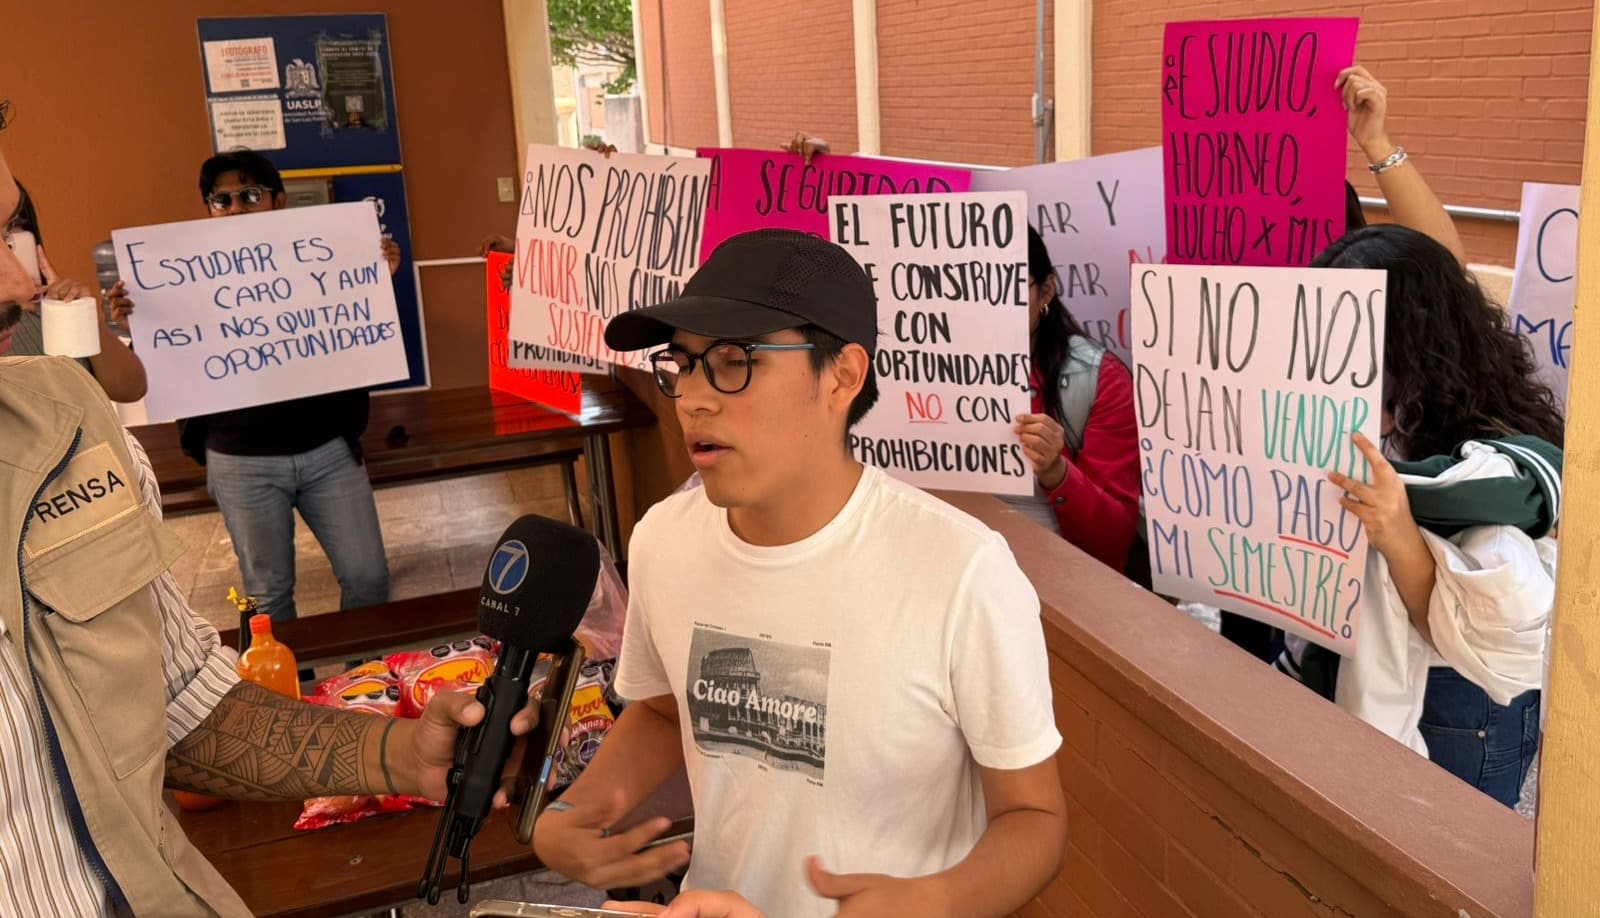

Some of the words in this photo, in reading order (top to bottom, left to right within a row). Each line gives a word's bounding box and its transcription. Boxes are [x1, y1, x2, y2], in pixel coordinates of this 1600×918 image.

[1170, 132, 1304, 206] HORNEO,
[591, 161, 709, 277] PROHÍBEN
[835, 202, 870, 246] EL
[890, 201, 1014, 250] FUTURO
[1037, 201, 1079, 238] AR
[1096, 179, 1119, 227] Y
[292, 237, 334, 262] ES
[1172, 203, 1247, 265] LUCHO
[214, 277, 292, 309] CARO
[310, 271, 327, 296] Y
[339, 262, 379, 290] AUN
[516, 238, 584, 308] VENDER,
[585, 253, 620, 320] NOS
[864, 262, 879, 302] E
[891, 260, 1028, 306] CONSTRUYE
[1055, 262, 1108, 298] JAR
[153, 324, 203, 349] ASI
[220, 316, 269, 339] NOS
[276, 297, 371, 333] QUITAN
[894, 309, 952, 345] CON
[1141, 270, 1175, 357] SI
[1196, 276, 1260, 373] NO
[1286, 283, 1383, 388] NOS
[204, 321, 396, 380] OPORTUNIDADES
[875, 349, 1032, 393] ORTUNIDADES
[905, 391, 944, 422] NO
[956, 395, 1012, 424] CON
[1136, 363, 1244, 456] DEJAN
[1261, 388, 1369, 484] VENDER
[849, 434, 1026, 478] PROHIBICIONES
[34, 470, 125, 523] RENSA
[1269, 469, 1364, 554] PAGO
[494, 544, 527, 593] 7
[1151, 518, 1194, 579] MI
[1207, 526, 1362, 639] SEMESTRE?
[480, 596, 509, 614] CANAL
[514, 606, 521, 616] 7
[692, 679, 741, 706] Ciao
[745, 687, 818, 723] Amore
